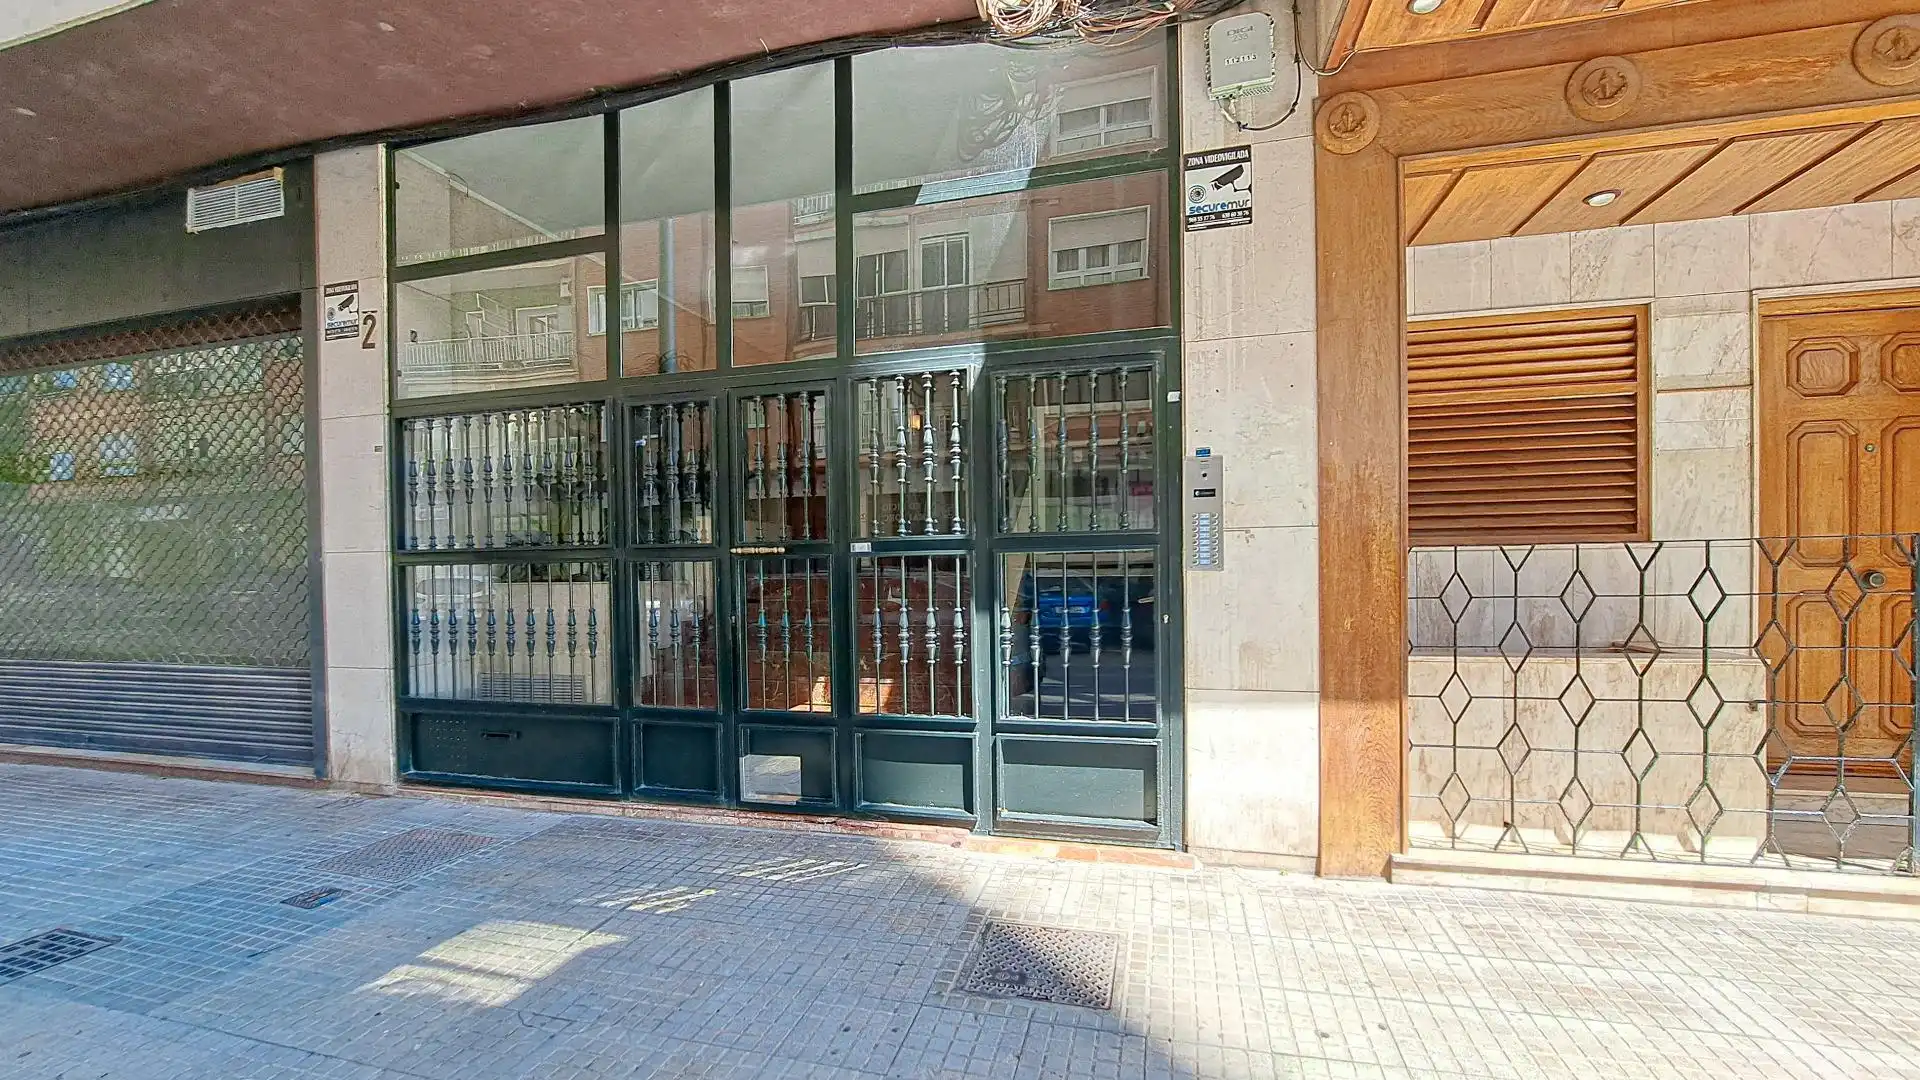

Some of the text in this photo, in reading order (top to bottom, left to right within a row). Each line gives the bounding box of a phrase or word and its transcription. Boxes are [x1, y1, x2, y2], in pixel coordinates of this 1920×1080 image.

[1187, 150, 1249, 167] ZONA VIDEOVIGILADA
[1189, 200, 1250, 214] securemur
[362, 314, 377, 349] 2
